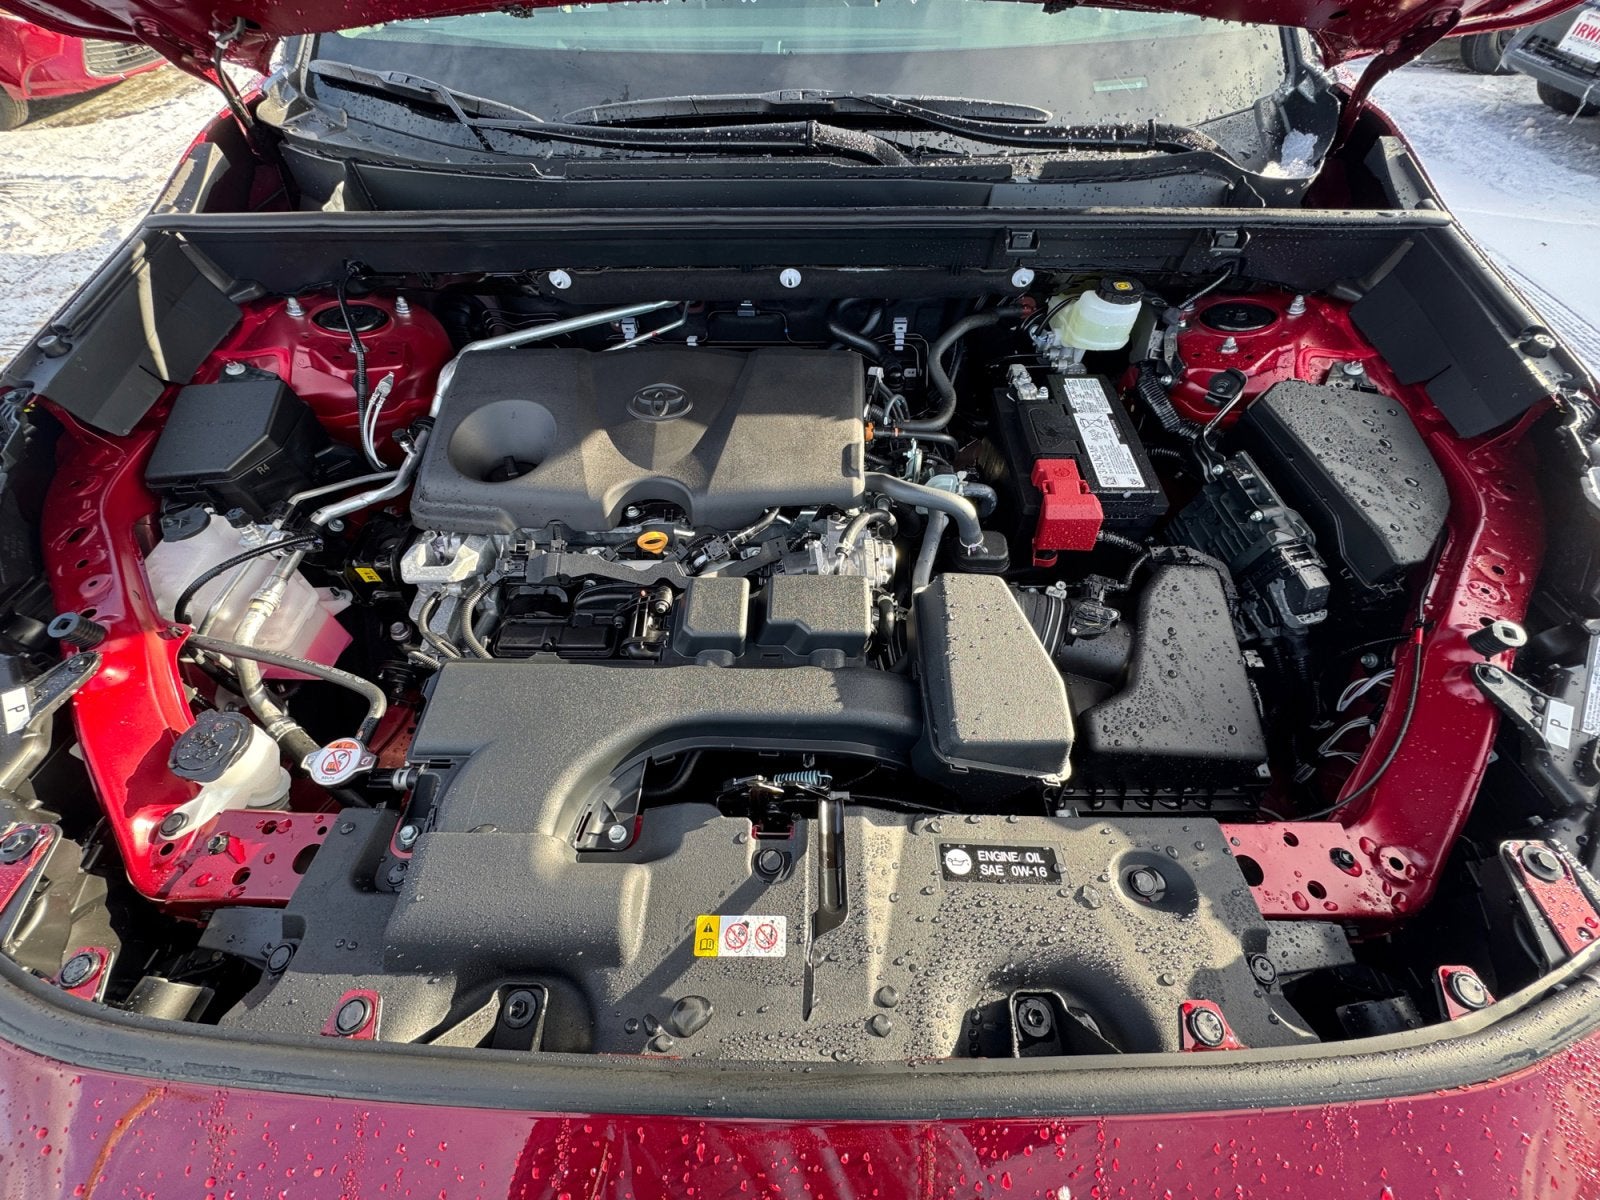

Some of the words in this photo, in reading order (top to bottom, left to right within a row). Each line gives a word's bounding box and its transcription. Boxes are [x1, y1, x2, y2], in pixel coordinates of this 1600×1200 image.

[256, 463, 270, 475] R4
[977, 850, 1018, 862] ENGINE
[1026, 852, 1045, 864] OIL
[980, 864, 1004, 876] SAE
[1011, 866, 1048, 878] 0W-16
